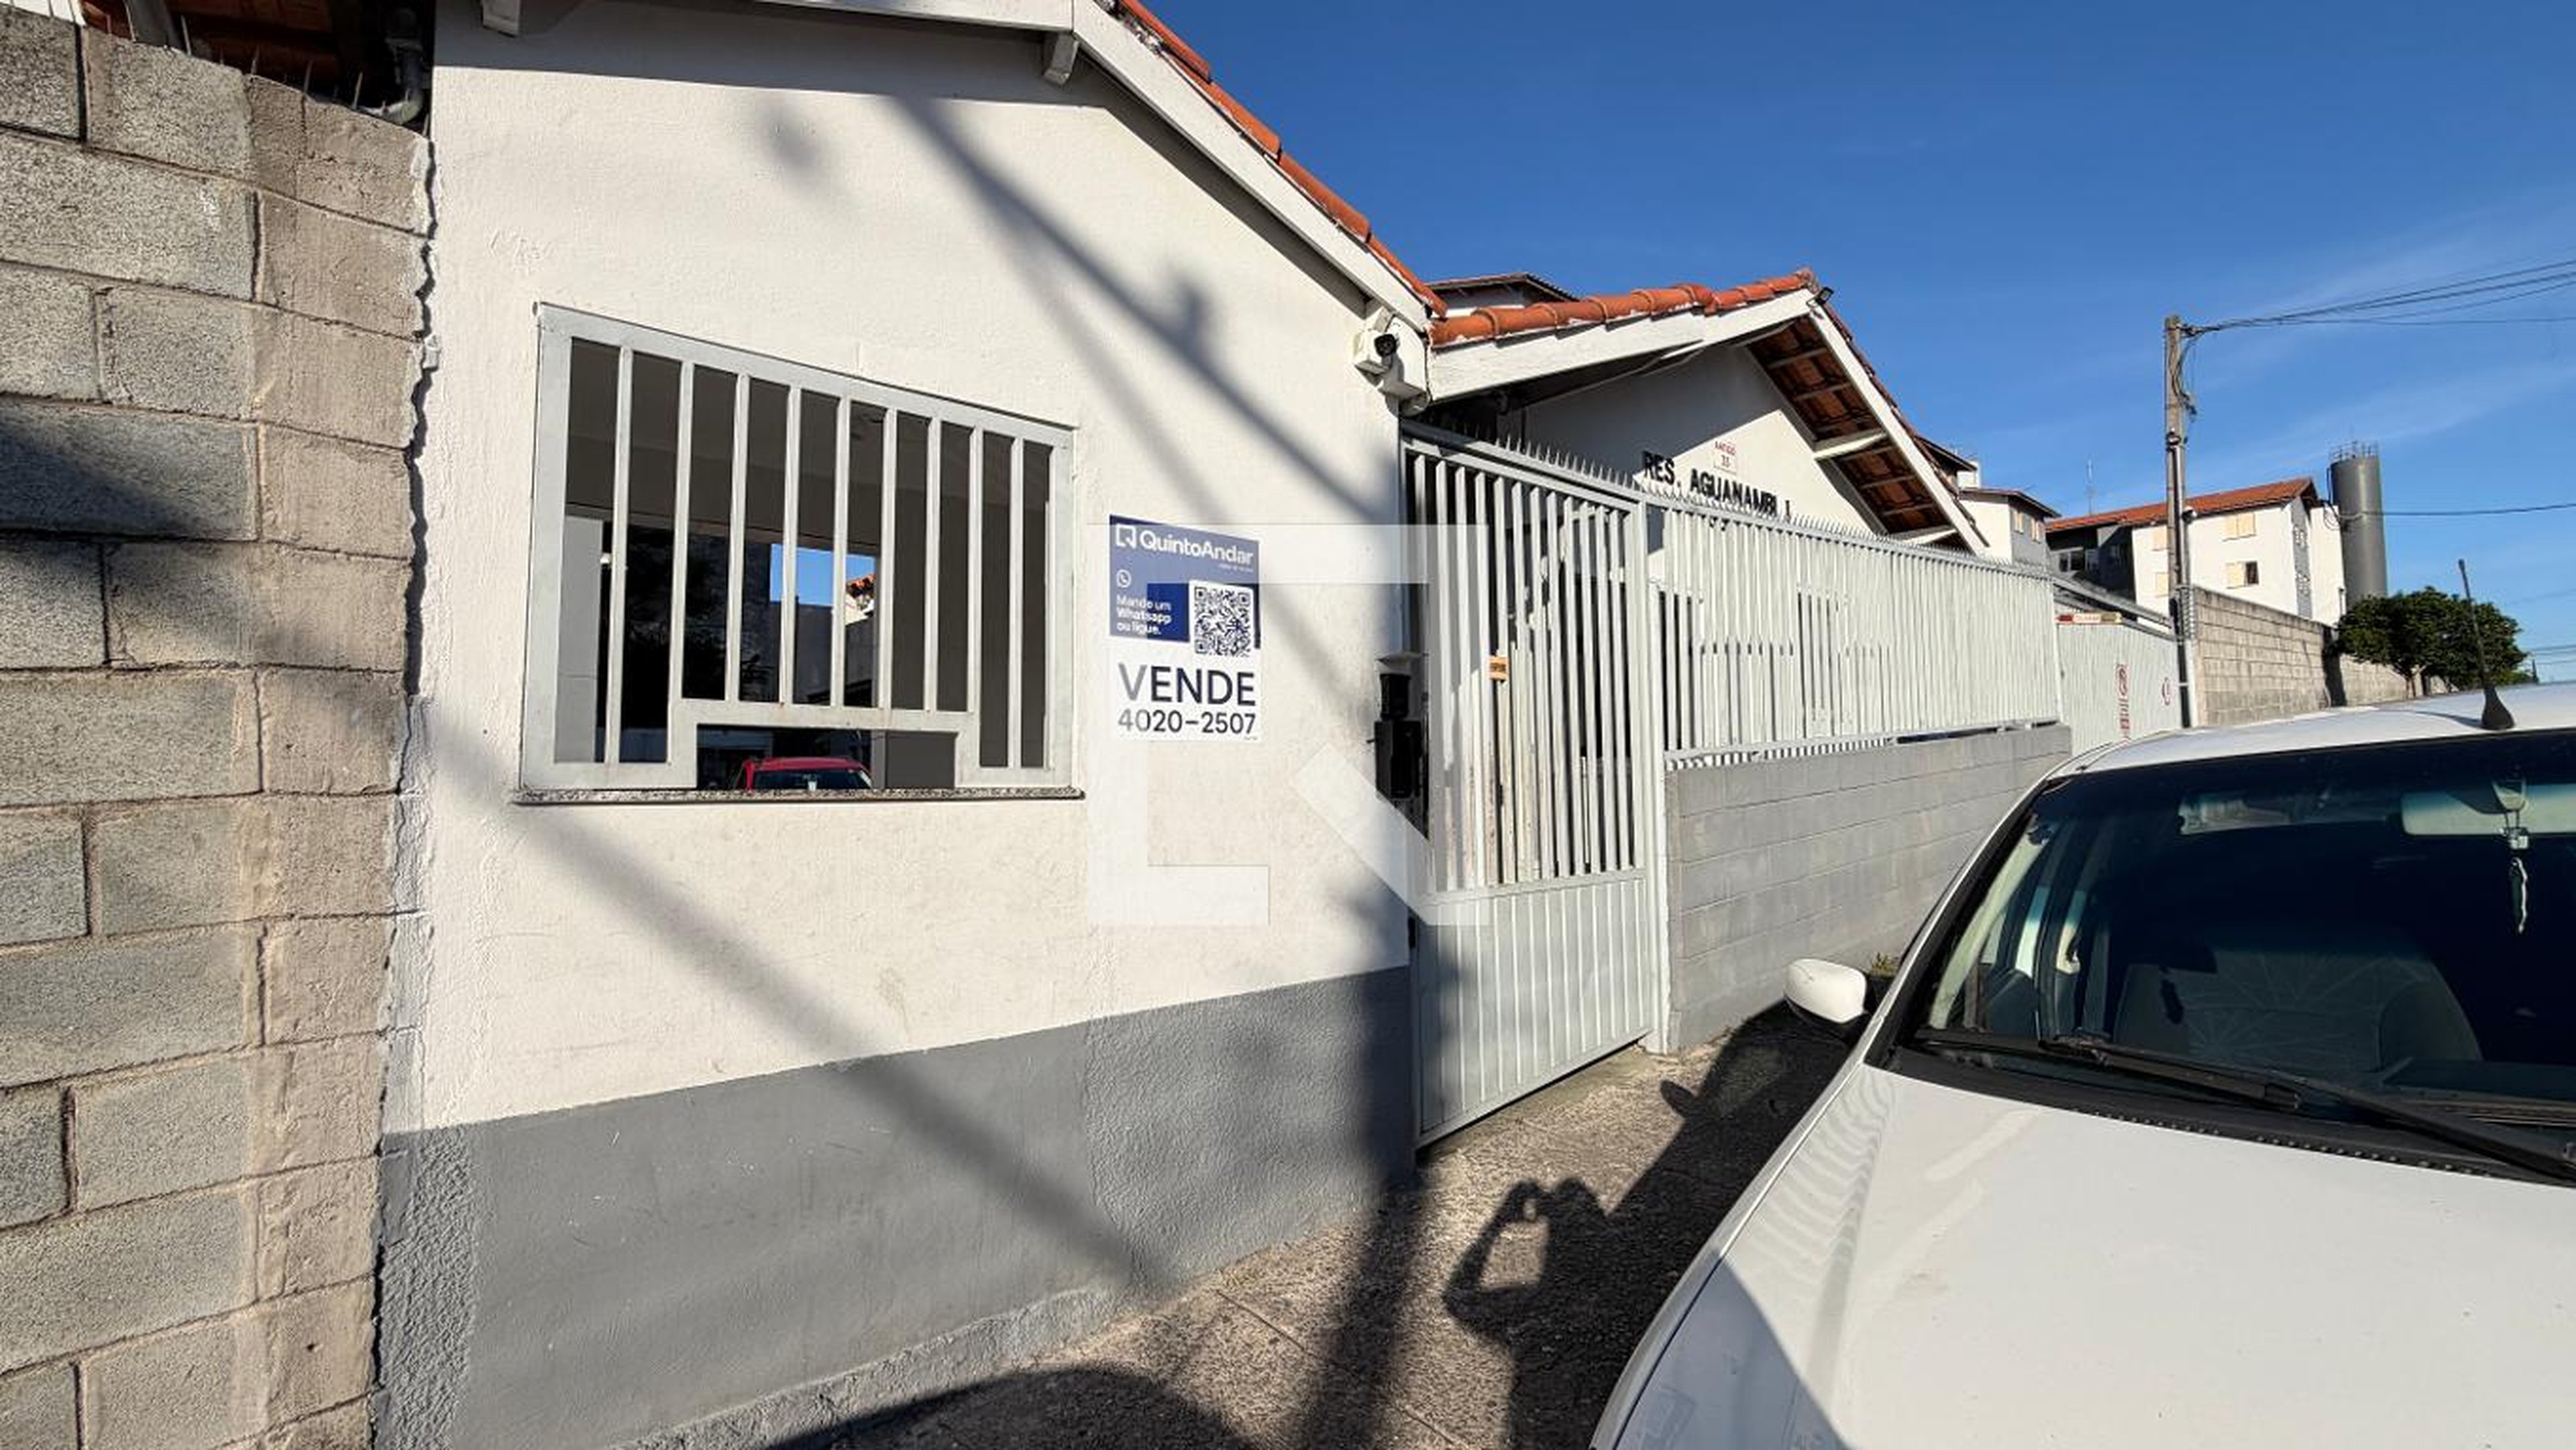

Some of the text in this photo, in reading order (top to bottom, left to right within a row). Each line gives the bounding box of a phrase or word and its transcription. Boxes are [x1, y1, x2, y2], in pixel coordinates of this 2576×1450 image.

[1643, 450, 1681, 488] RES.
[1140, 529, 1254, 566] QuintoAndar
[1155, 602, 1171, 611] um
[1116, 622, 1131, 631] ou
[1118, 663, 1256, 707] VENDE
[1118, 708, 1256, 735] 4020-2507
